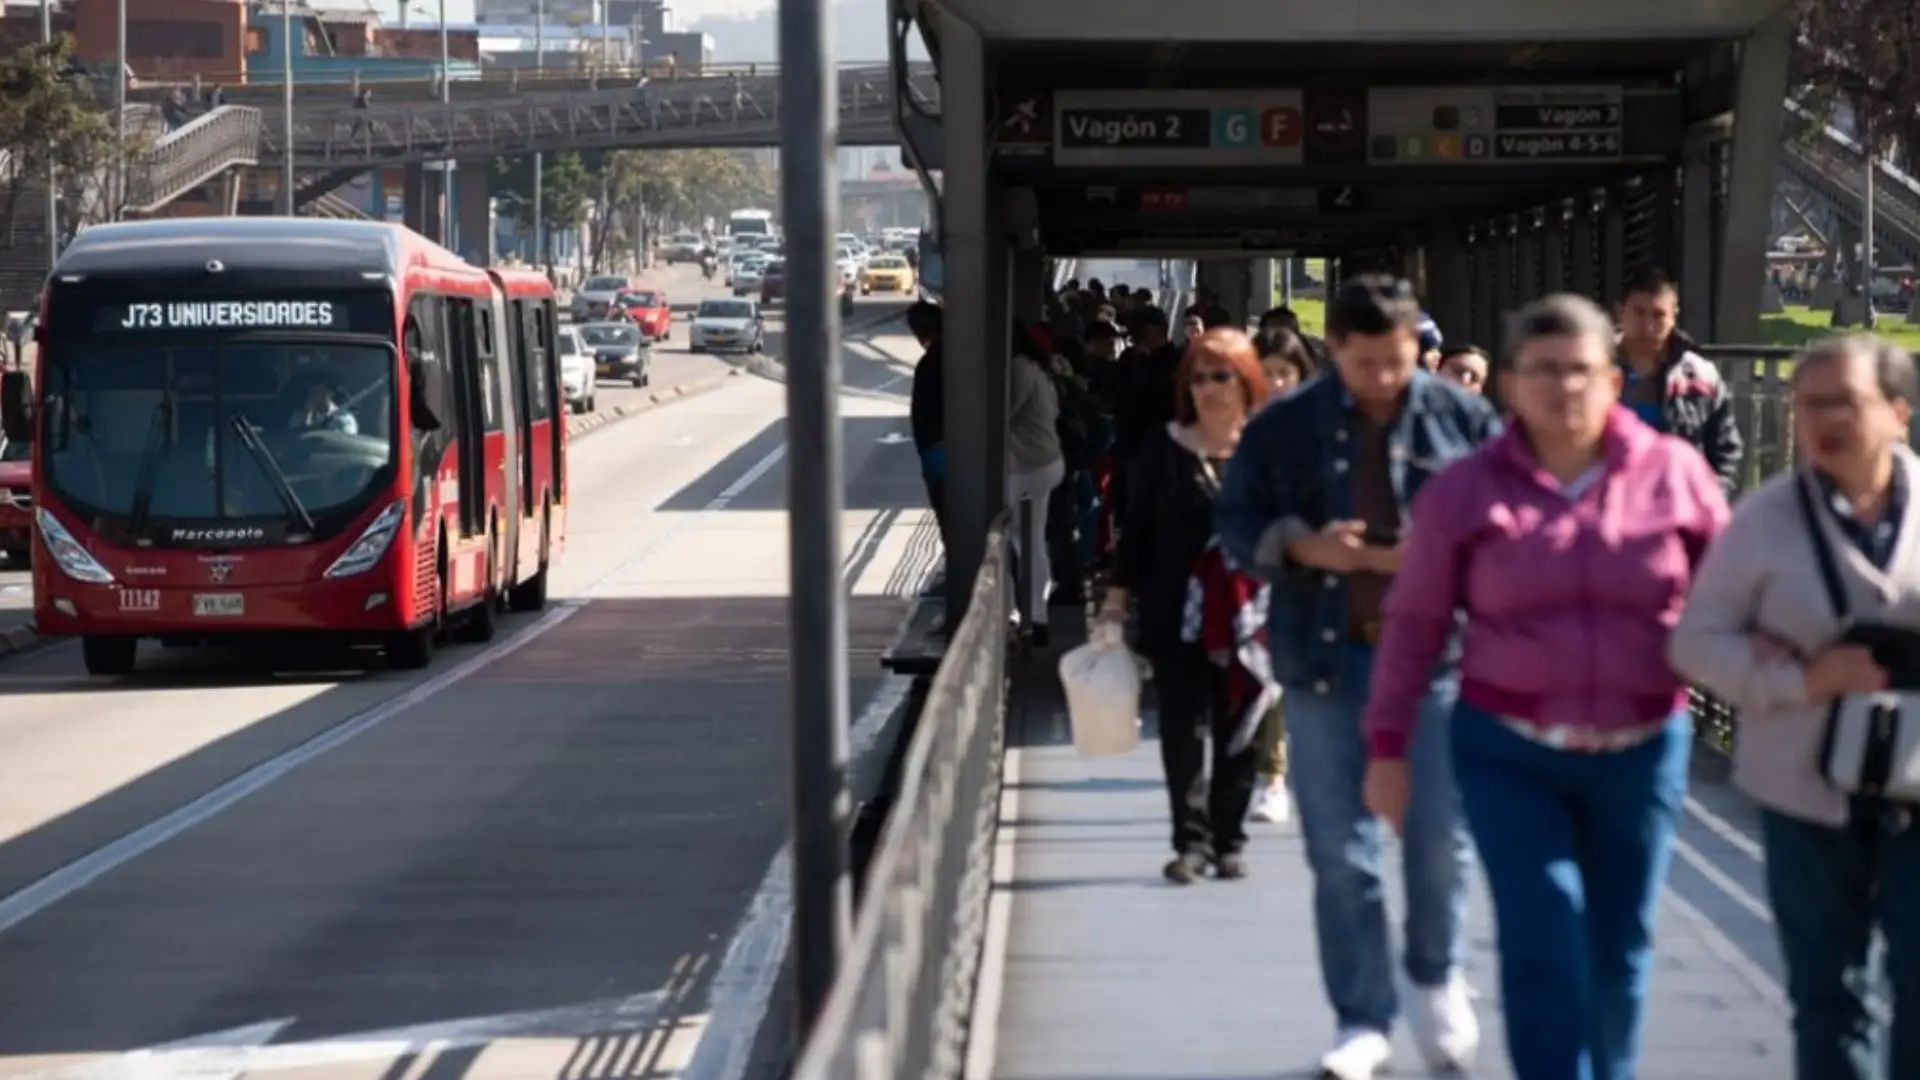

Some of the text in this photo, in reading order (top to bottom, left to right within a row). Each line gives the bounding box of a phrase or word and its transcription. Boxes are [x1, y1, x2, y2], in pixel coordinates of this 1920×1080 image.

[1067, 113, 1182, 144] Vagón 2
[1225, 114, 1248, 143] G
[1270, 113, 1289, 141] F
[1539, 108, 1601, 127] Vagón
[1501, 137, 1617, 157] Vagón 4-5-6
[121, 301, 333, 328] J73 UNIVERSIDADES
